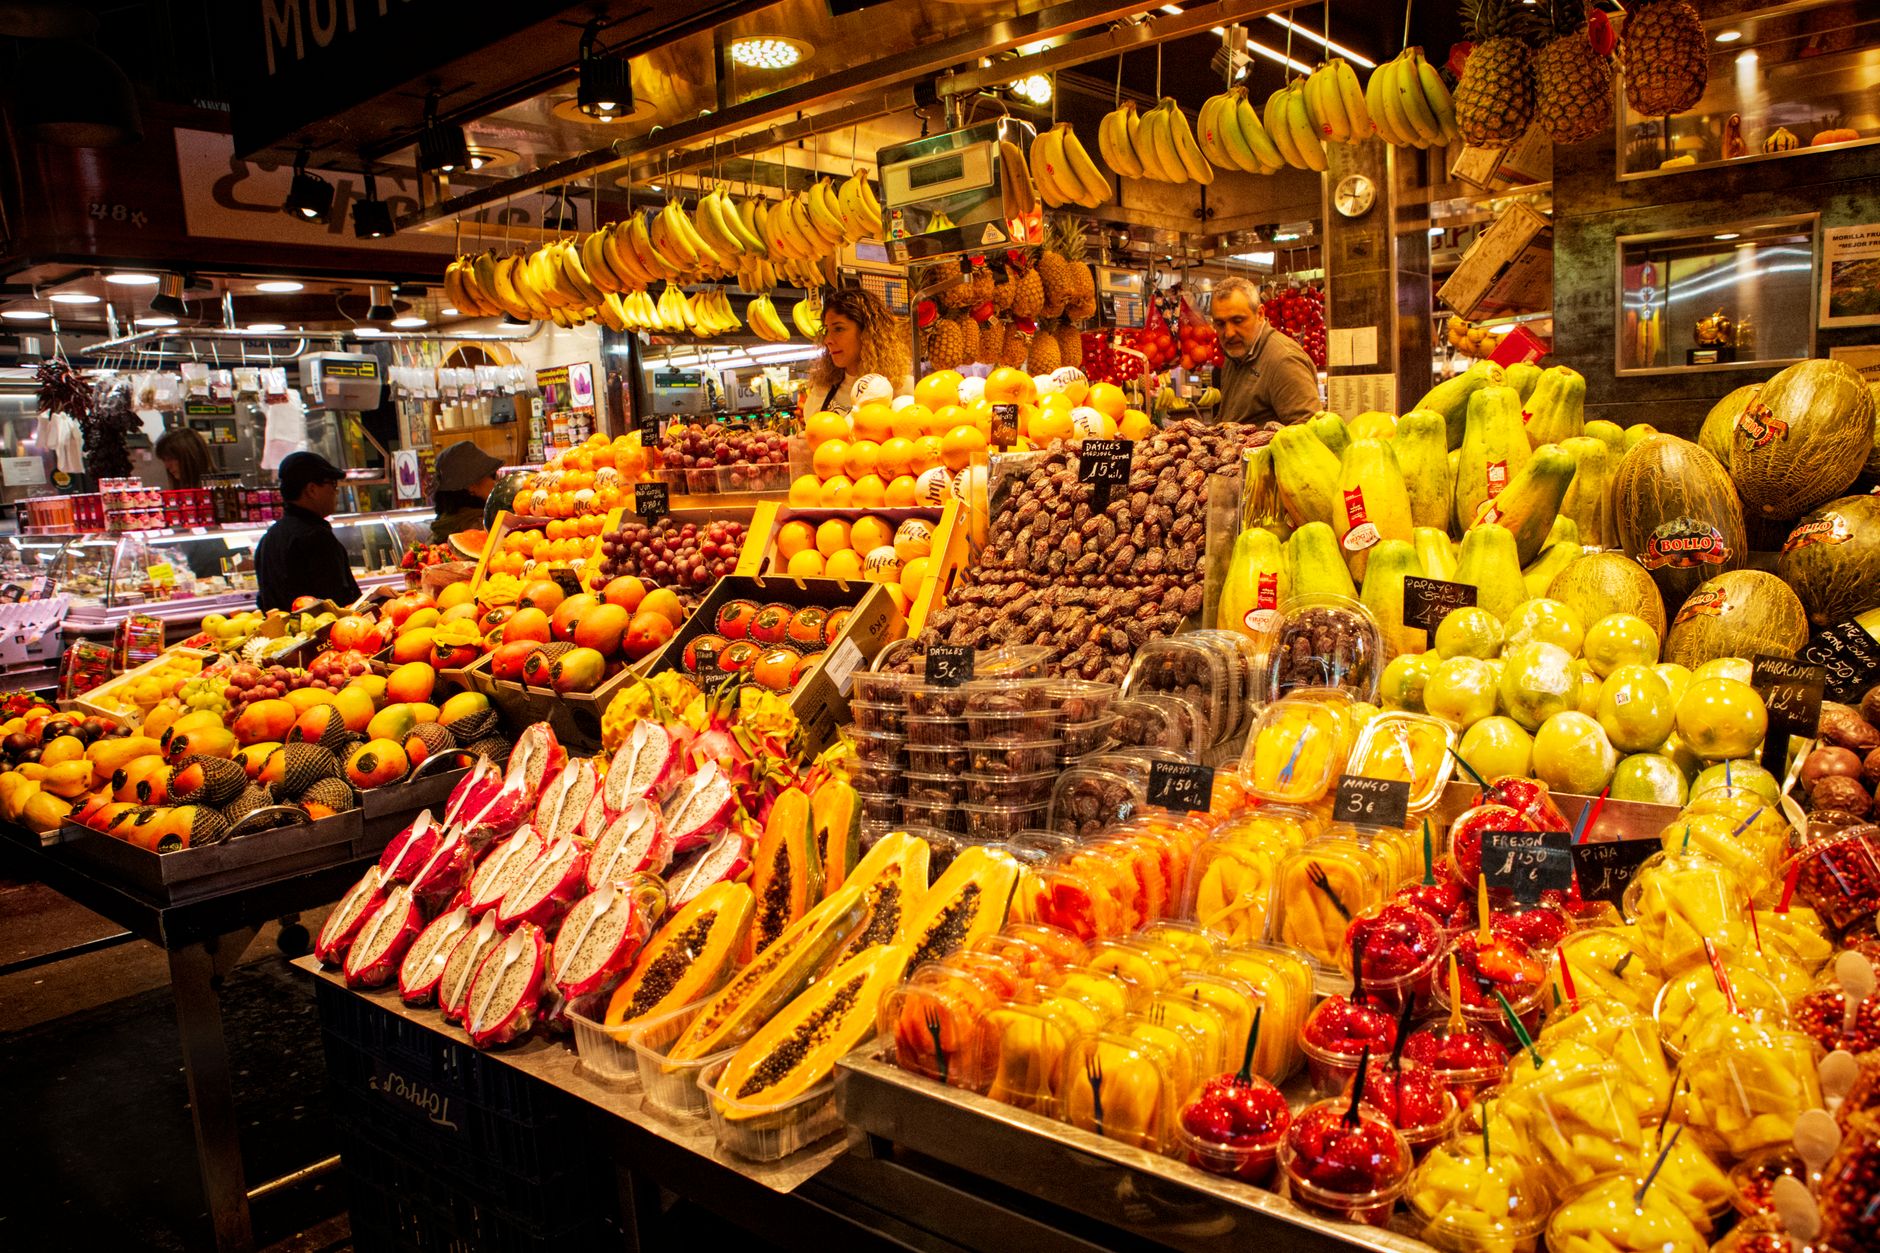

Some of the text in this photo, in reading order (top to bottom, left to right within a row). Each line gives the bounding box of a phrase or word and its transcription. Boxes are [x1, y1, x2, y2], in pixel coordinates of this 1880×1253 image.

[1660, 536, 1712, 552] BOLLO
[1156, 763, 1190, 775] PAPAYA
[1342, 779, 1390, 792] MANGO
[1580, 845, 1618, 862] PIÑA
